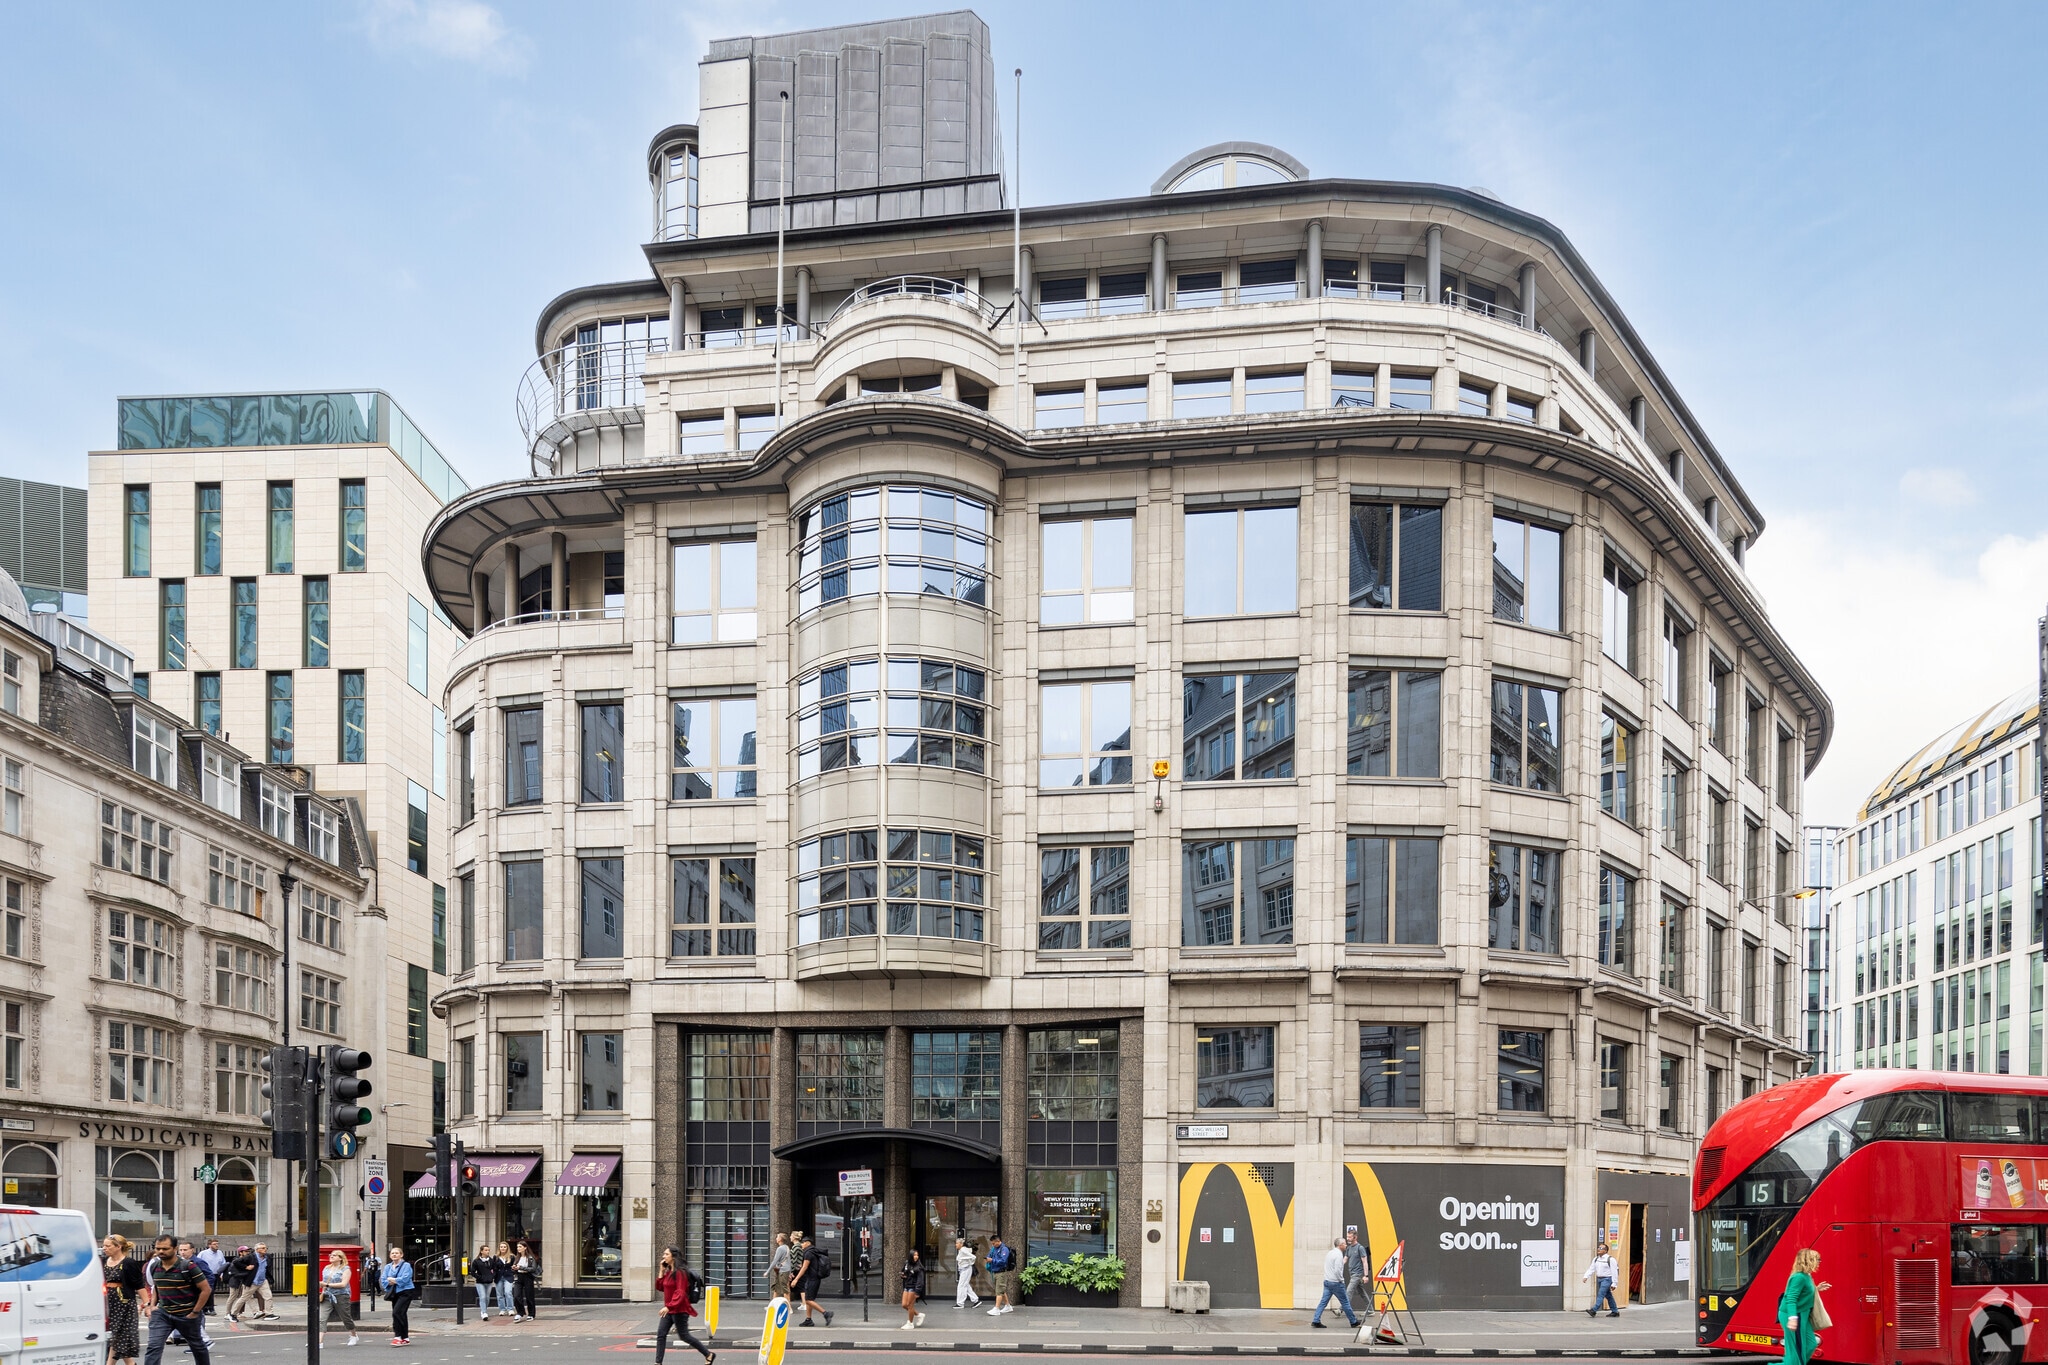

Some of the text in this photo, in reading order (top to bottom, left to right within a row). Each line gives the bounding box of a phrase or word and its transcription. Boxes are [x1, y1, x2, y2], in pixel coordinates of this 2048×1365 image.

[80, 1122, 271, 1152] SYNDICATE BAN
[633, 1197, 648, 1209] 55
[1752, 1184, 1769, 1203] 15
[1146, 1199, 1163, 1212] 55
[1439, 1194, 1540, 1227] Opening
[1075, 1221, 1092, 1231] hre
[1439, 1231, 1518, 1250] soon...
